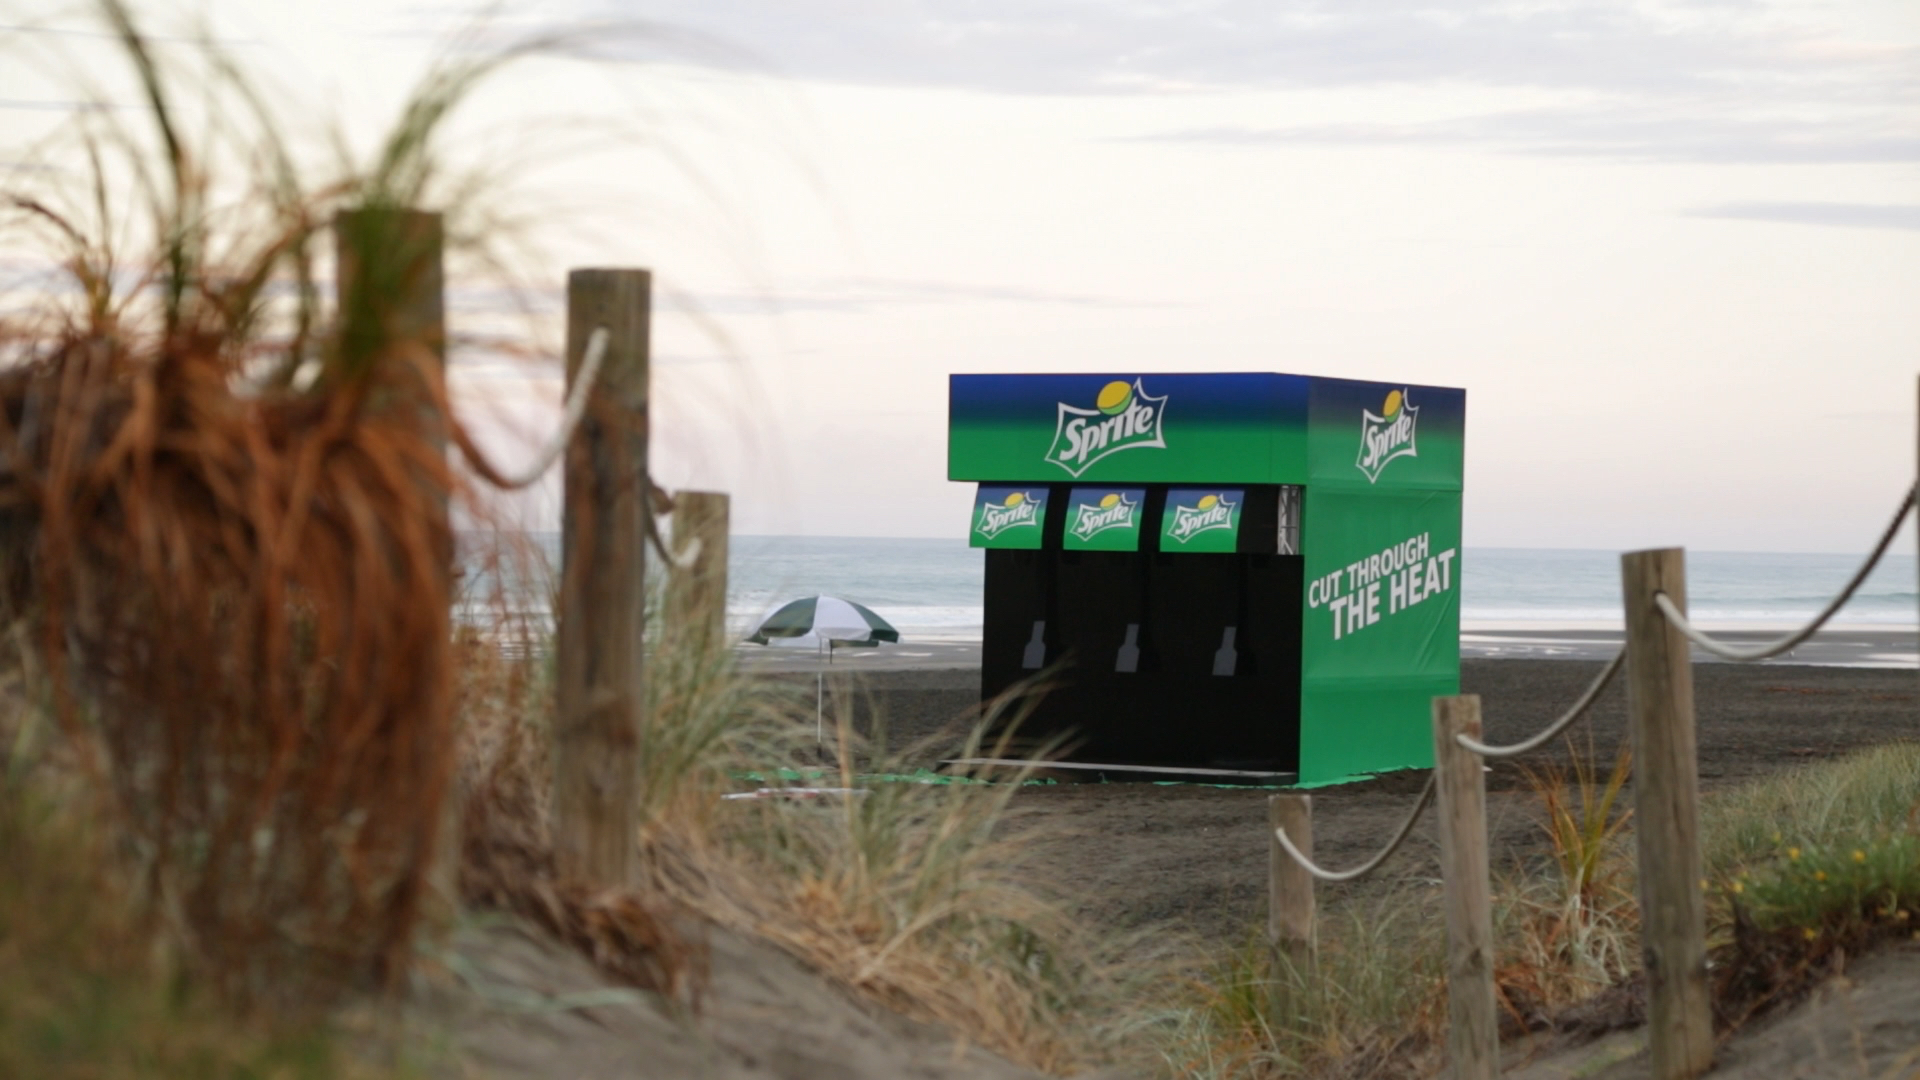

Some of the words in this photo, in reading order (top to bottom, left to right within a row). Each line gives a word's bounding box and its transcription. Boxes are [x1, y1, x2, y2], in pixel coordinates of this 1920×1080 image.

[1059, 396, 1154, 464] Sprite
[1363, 406, 1412, 471] Sprite
[983, 501, 1032, 533] Sprite
[1077, 503, 1128, 534] Sprite
[1175, 503, 1227, 536] Sprite
[1308, 569, 1343, 608] CUT
[1346, 532, 1429, 591] THROUGH
[1329, 581, 1380, 640] THE
[1390, 548, 1456, 615] HEAT
